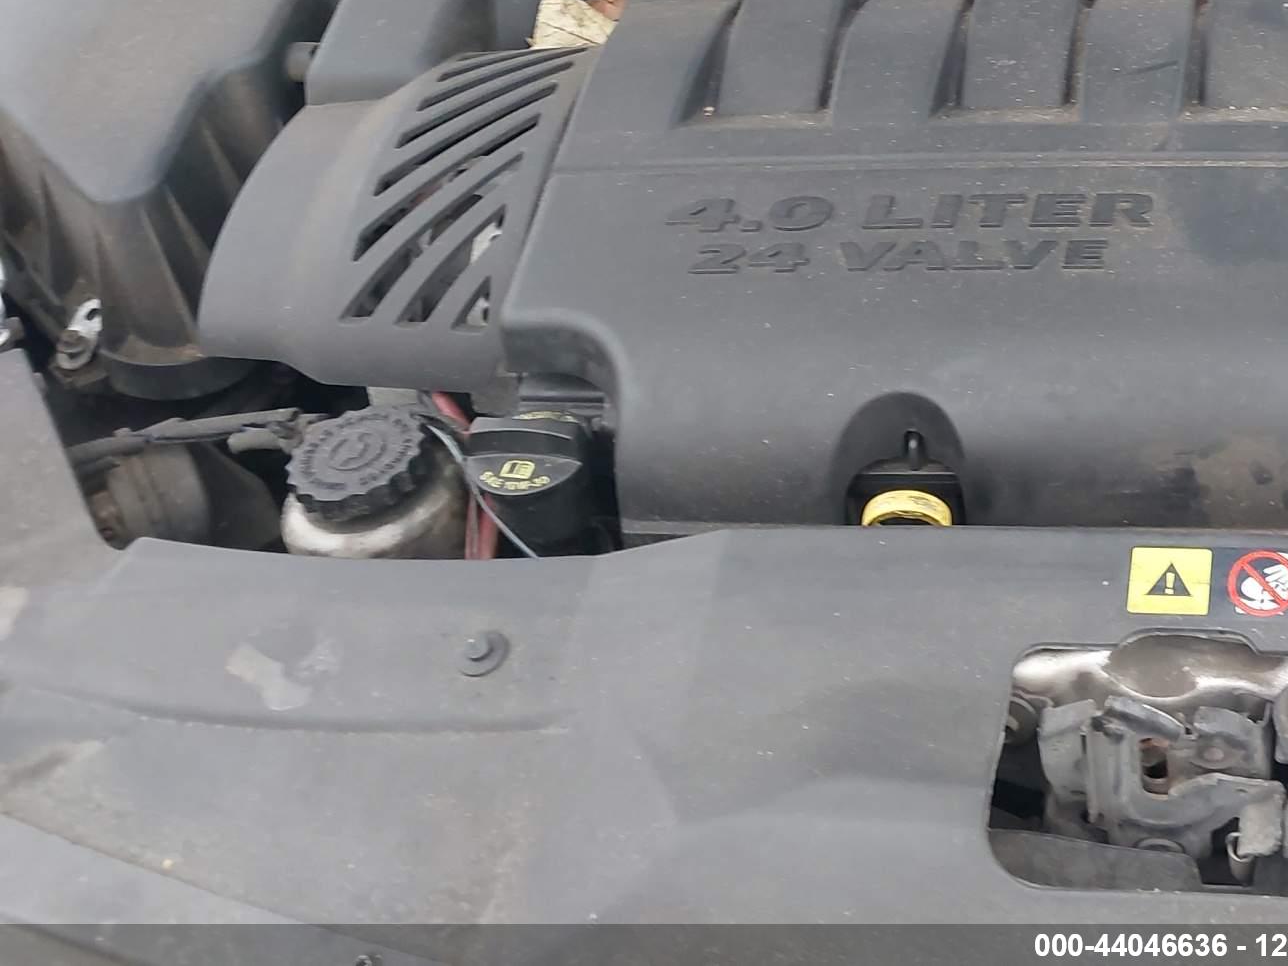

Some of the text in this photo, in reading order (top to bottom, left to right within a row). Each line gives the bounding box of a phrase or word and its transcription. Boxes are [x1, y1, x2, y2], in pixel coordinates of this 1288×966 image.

[663, 192, 1155, 233] 4.0 LITER
[687, 238, 1111, 275] 24 VALVE
